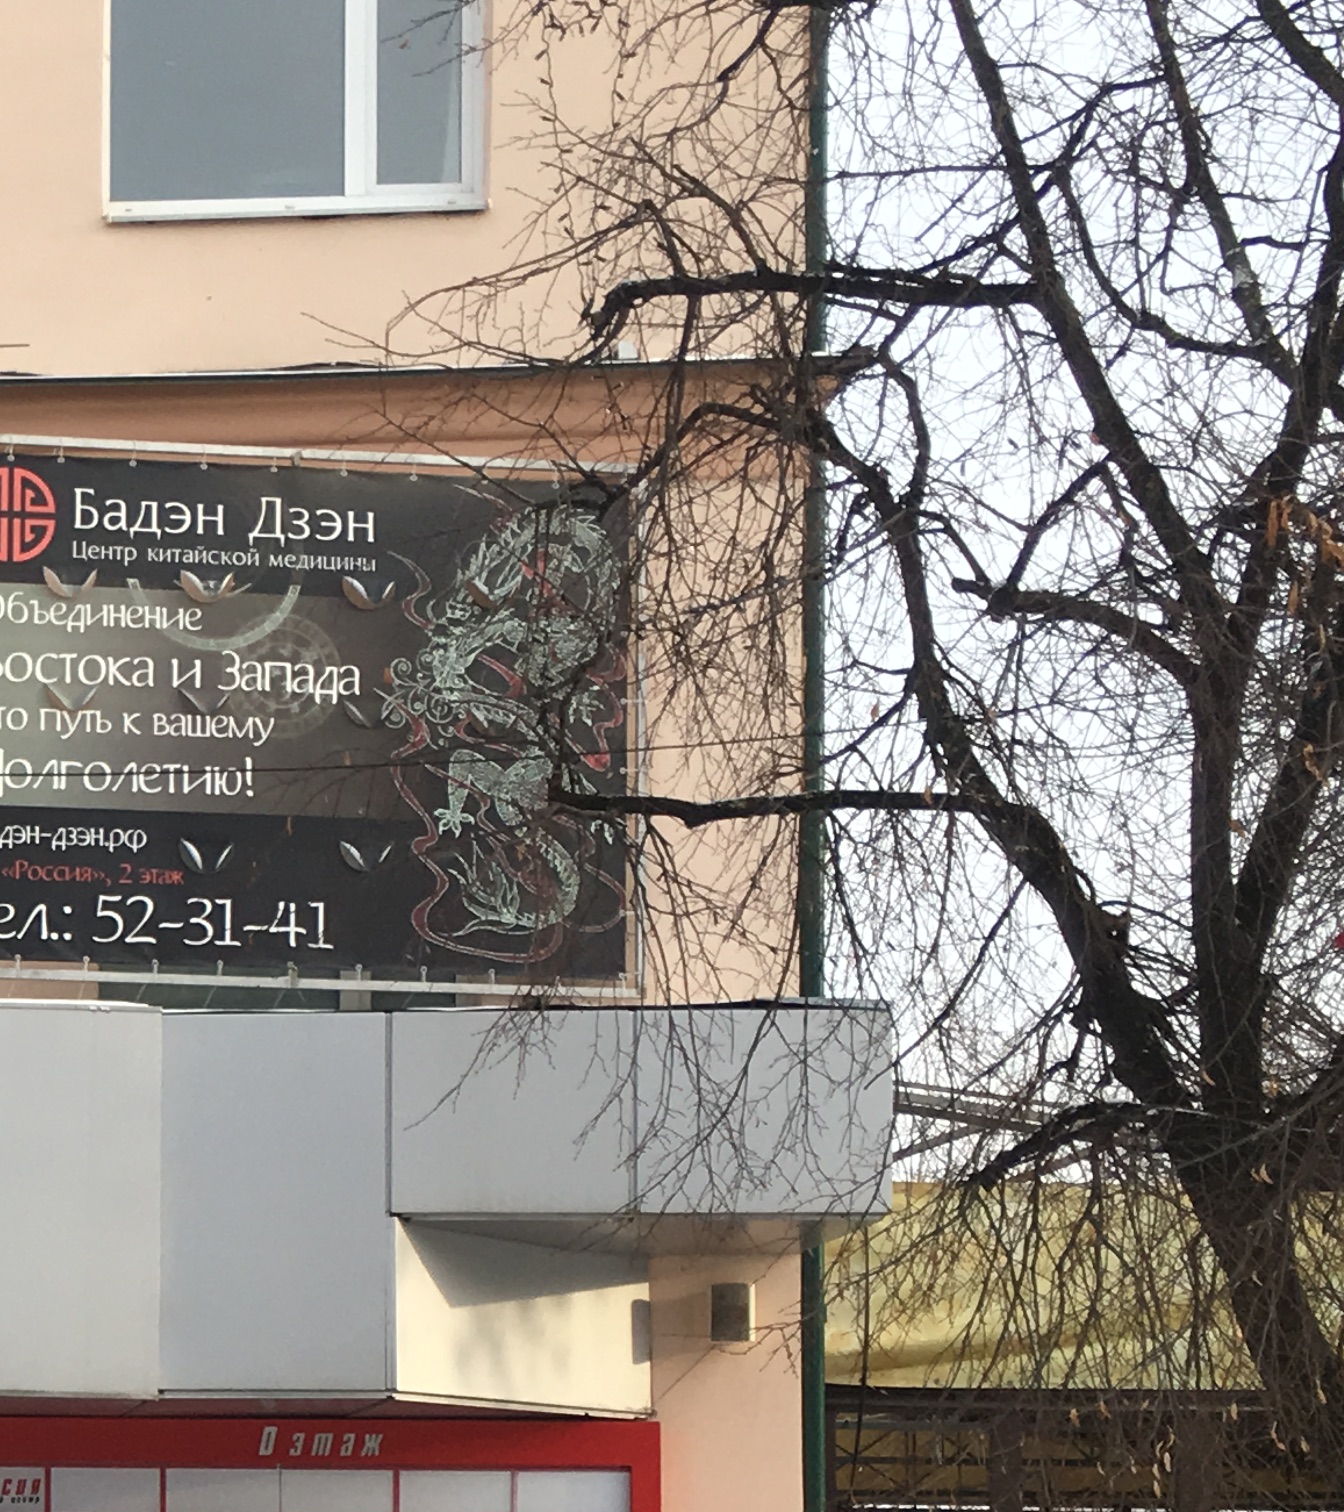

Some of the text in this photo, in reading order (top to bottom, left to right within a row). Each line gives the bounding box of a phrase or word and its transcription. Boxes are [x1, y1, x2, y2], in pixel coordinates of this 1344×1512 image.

[73, 487, 376, 545] Бадэн Дзэн
[72, 541, 376, 573] Центр китайской медицины
[171, 657, 200, 688] и
[217, 650, 361, 704] Запада
[39, 706, 109, 735] путь
[122, 712, 141, 735] к
[152, 713, 275, 746] вашему
[1, 861, 112, 886] «Россия»,
[119, 862, 133, 883] 2
[138, 868, 184, 887] этаж
[91, 895, 334, 951] 52-31-41
[259, 1426, 384, 1457] 0 этаж
